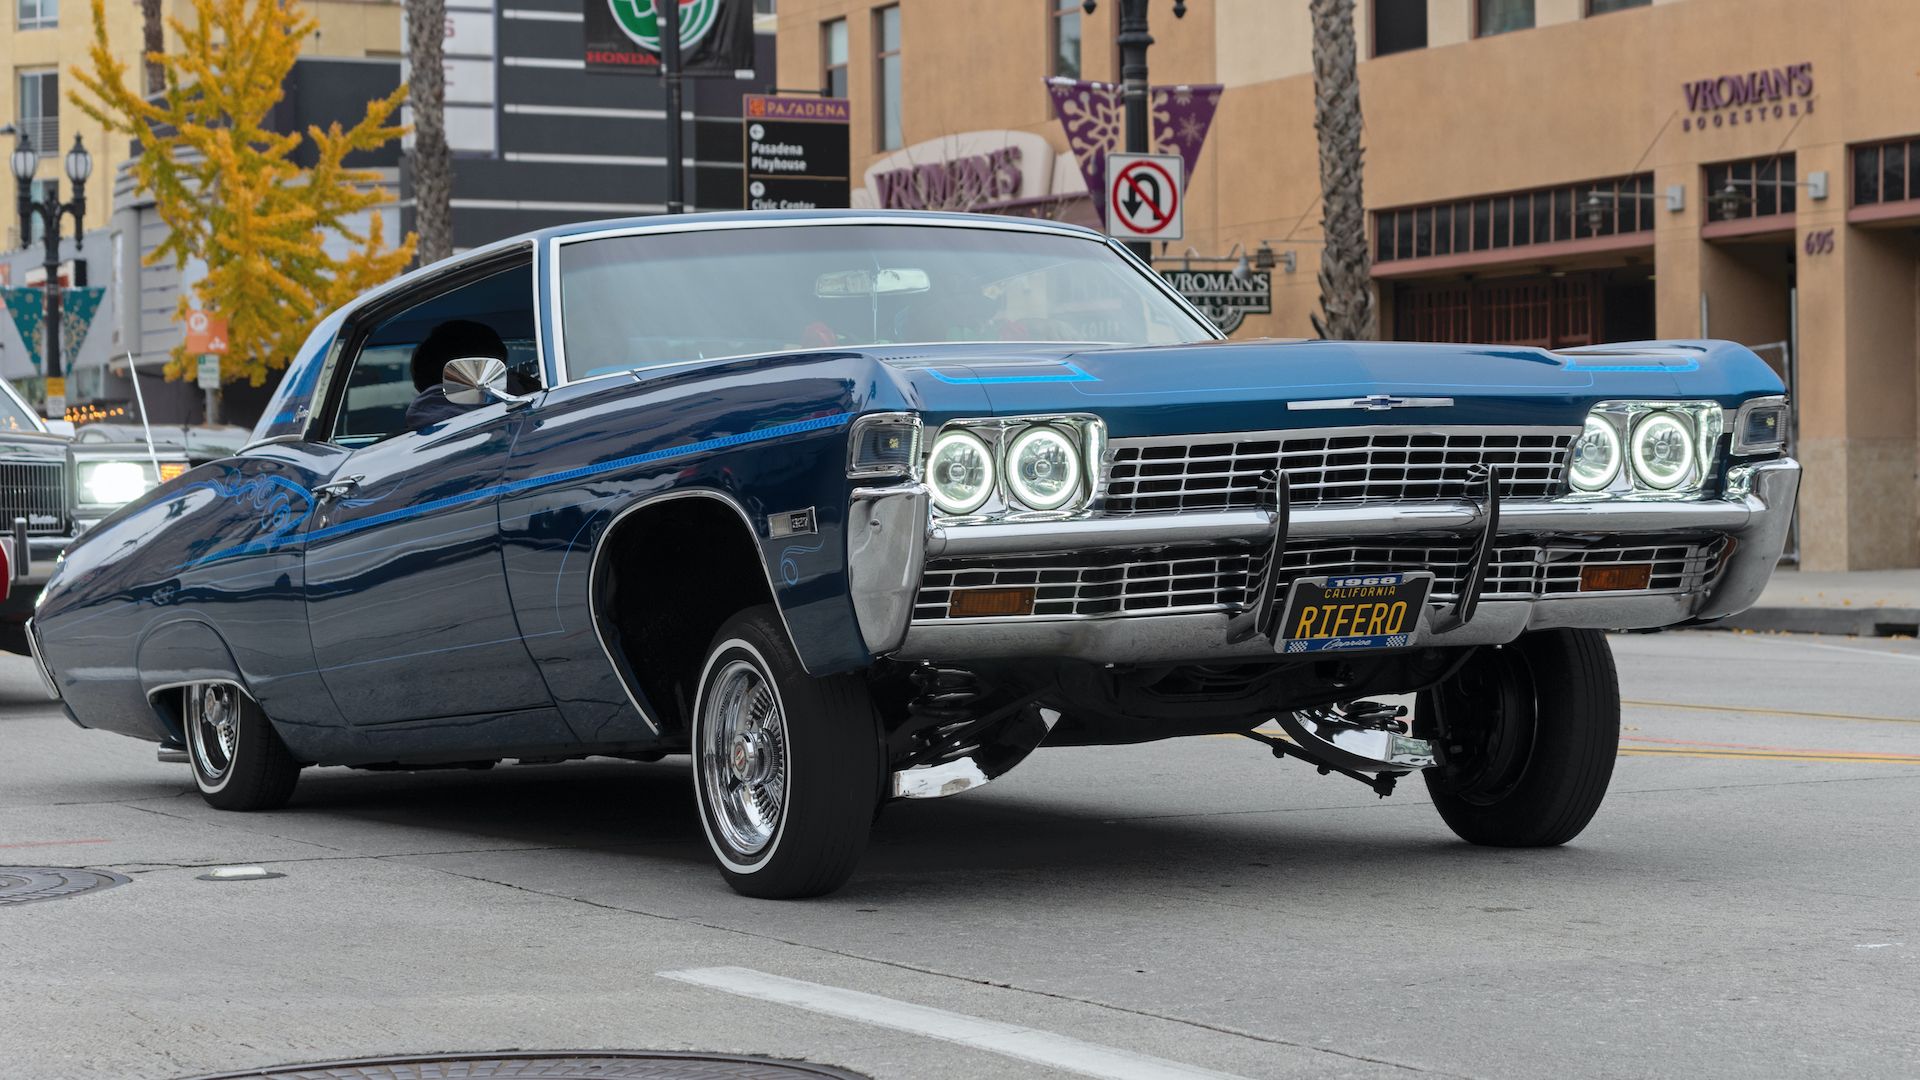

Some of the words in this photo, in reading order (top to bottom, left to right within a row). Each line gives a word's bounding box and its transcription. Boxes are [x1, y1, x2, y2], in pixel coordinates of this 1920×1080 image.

[586, 51, 658, 65] HONDA
[1683, 62, 1813, 112] VROMAN'S
[767, 102, 846, 117] PASADENA
[1683, 100, 1814, 132] BOOKSTORE
[751, 141, 803, 155] Pasadena
[751, 156, 807, 172] Playhouse
[1805, 228, 1834, 256] 695
[1166, 273, 1269, 291] VROMAN'S
[1334, 576, 1397, 587] 1968
[1325, 586, 1396, 599] CALIFORNIA
[1295, 601, 1408, 639] RIFERO
[1322, 639, 1372, 650] Caprice
